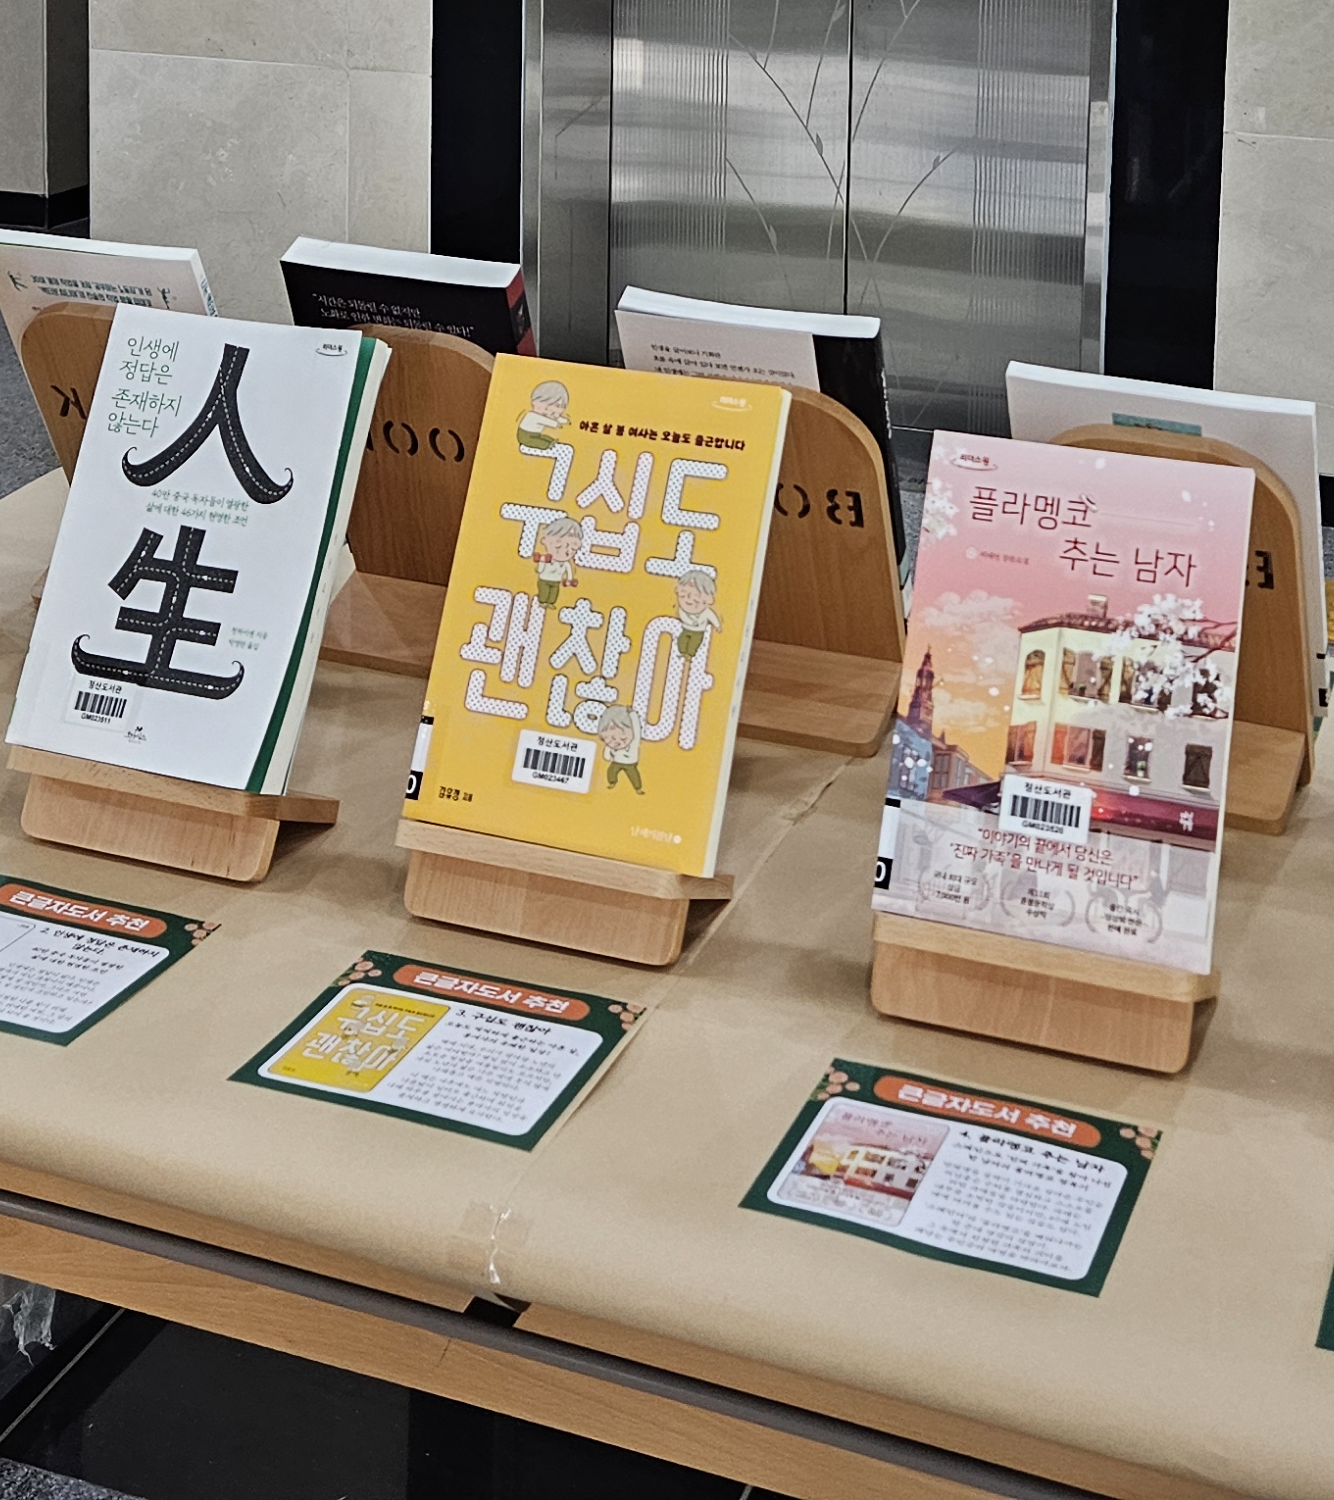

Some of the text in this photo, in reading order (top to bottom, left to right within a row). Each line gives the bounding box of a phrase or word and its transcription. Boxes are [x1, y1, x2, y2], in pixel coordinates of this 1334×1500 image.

[126, 338, 180, 362] 인생에
[119, 359, 173, 385] 정답은
[111, 388, 182, 416] 존재하지
[107, 412, 159, 438] 않는다
[968, 485, 1093, 530] 플라멩코
[1058, 537, 1124, 576] 추는
[1134, 549, 1197, 587] 남자
[1025, 782, 1072, 799] 정산도서관
[9, 891, 149, 932] 큰글자도서 추천
[414, 971, 569, 1014] 큰글자도서 추천
[898, 1083, 1019, 1123] 큰글자도서
